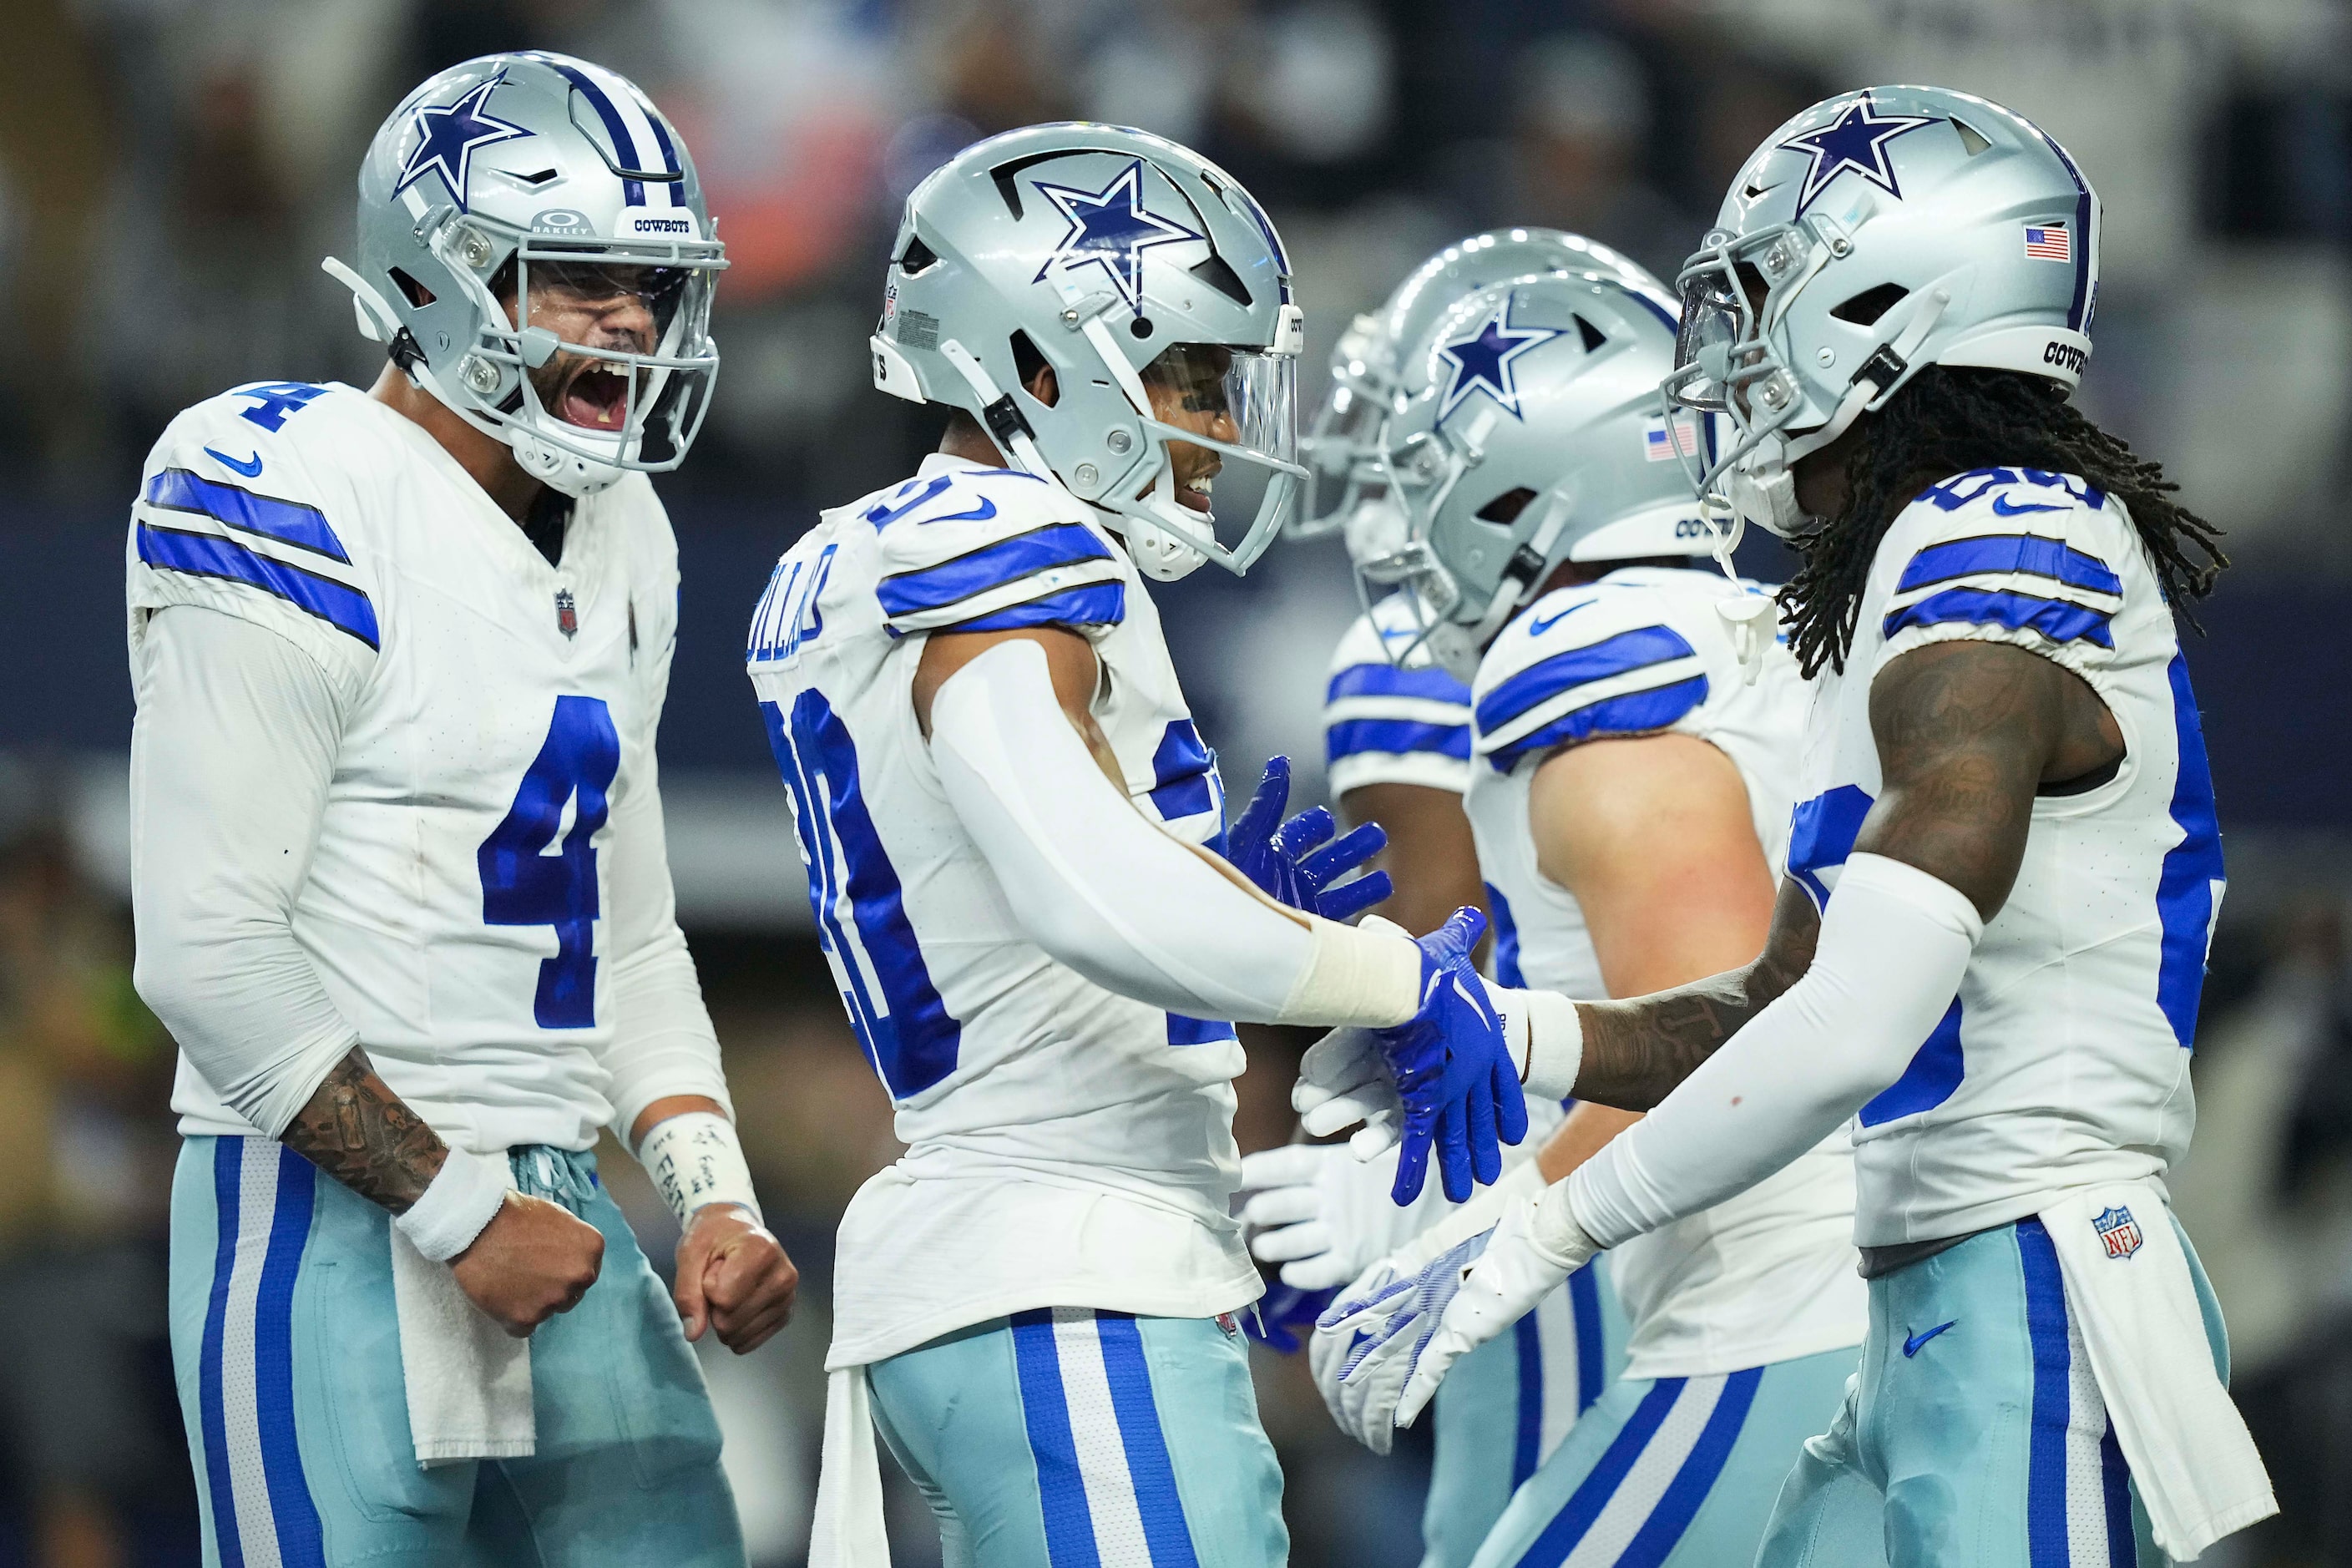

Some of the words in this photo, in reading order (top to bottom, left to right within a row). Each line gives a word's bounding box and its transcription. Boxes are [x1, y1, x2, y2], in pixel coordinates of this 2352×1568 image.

[533, 225, 589, 235] OAKLEY
[635, 219, 690, 233] COWBOYS
[231, 382, 327, 433] 4
[477, 695, 620, 1029] 4
[2103, 1225, 2140, 1254] NFL
